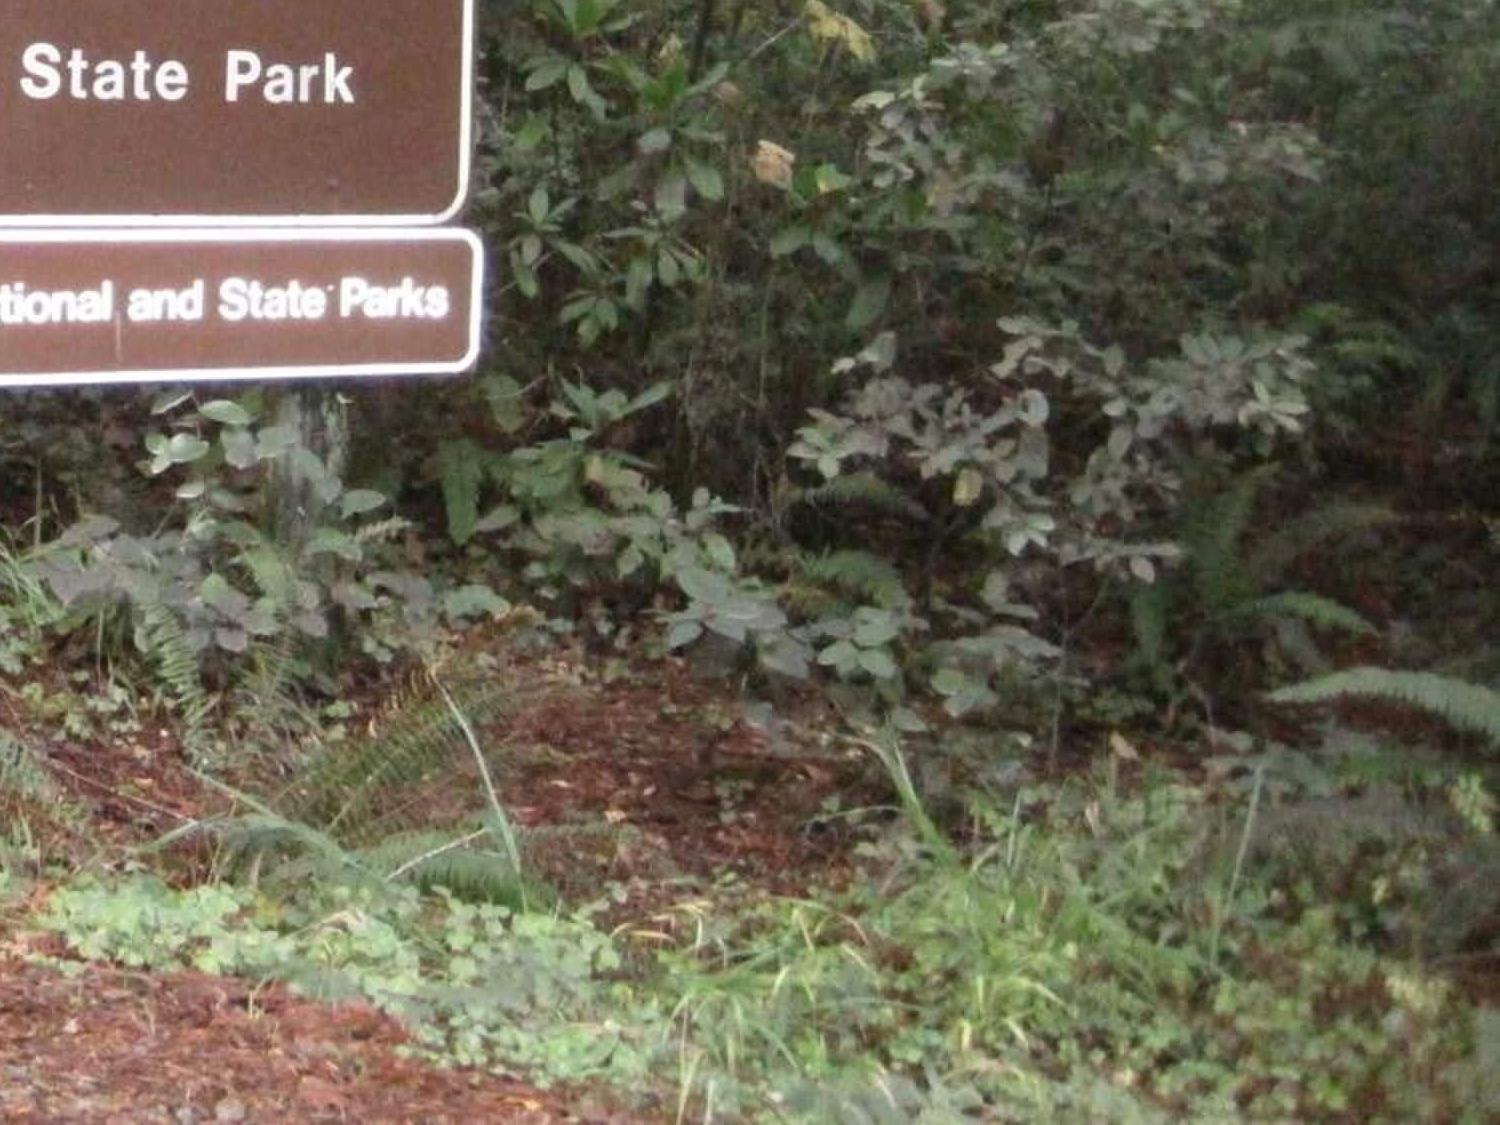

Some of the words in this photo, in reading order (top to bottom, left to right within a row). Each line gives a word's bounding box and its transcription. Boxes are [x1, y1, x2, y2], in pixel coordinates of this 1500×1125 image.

[19, 42, 189, 101] State
[225, 50, 355, 104] Park
[126, 279, 206, 323] and
[217, 277, 325, 322] State
[339, 276, 451, 320] Parks
